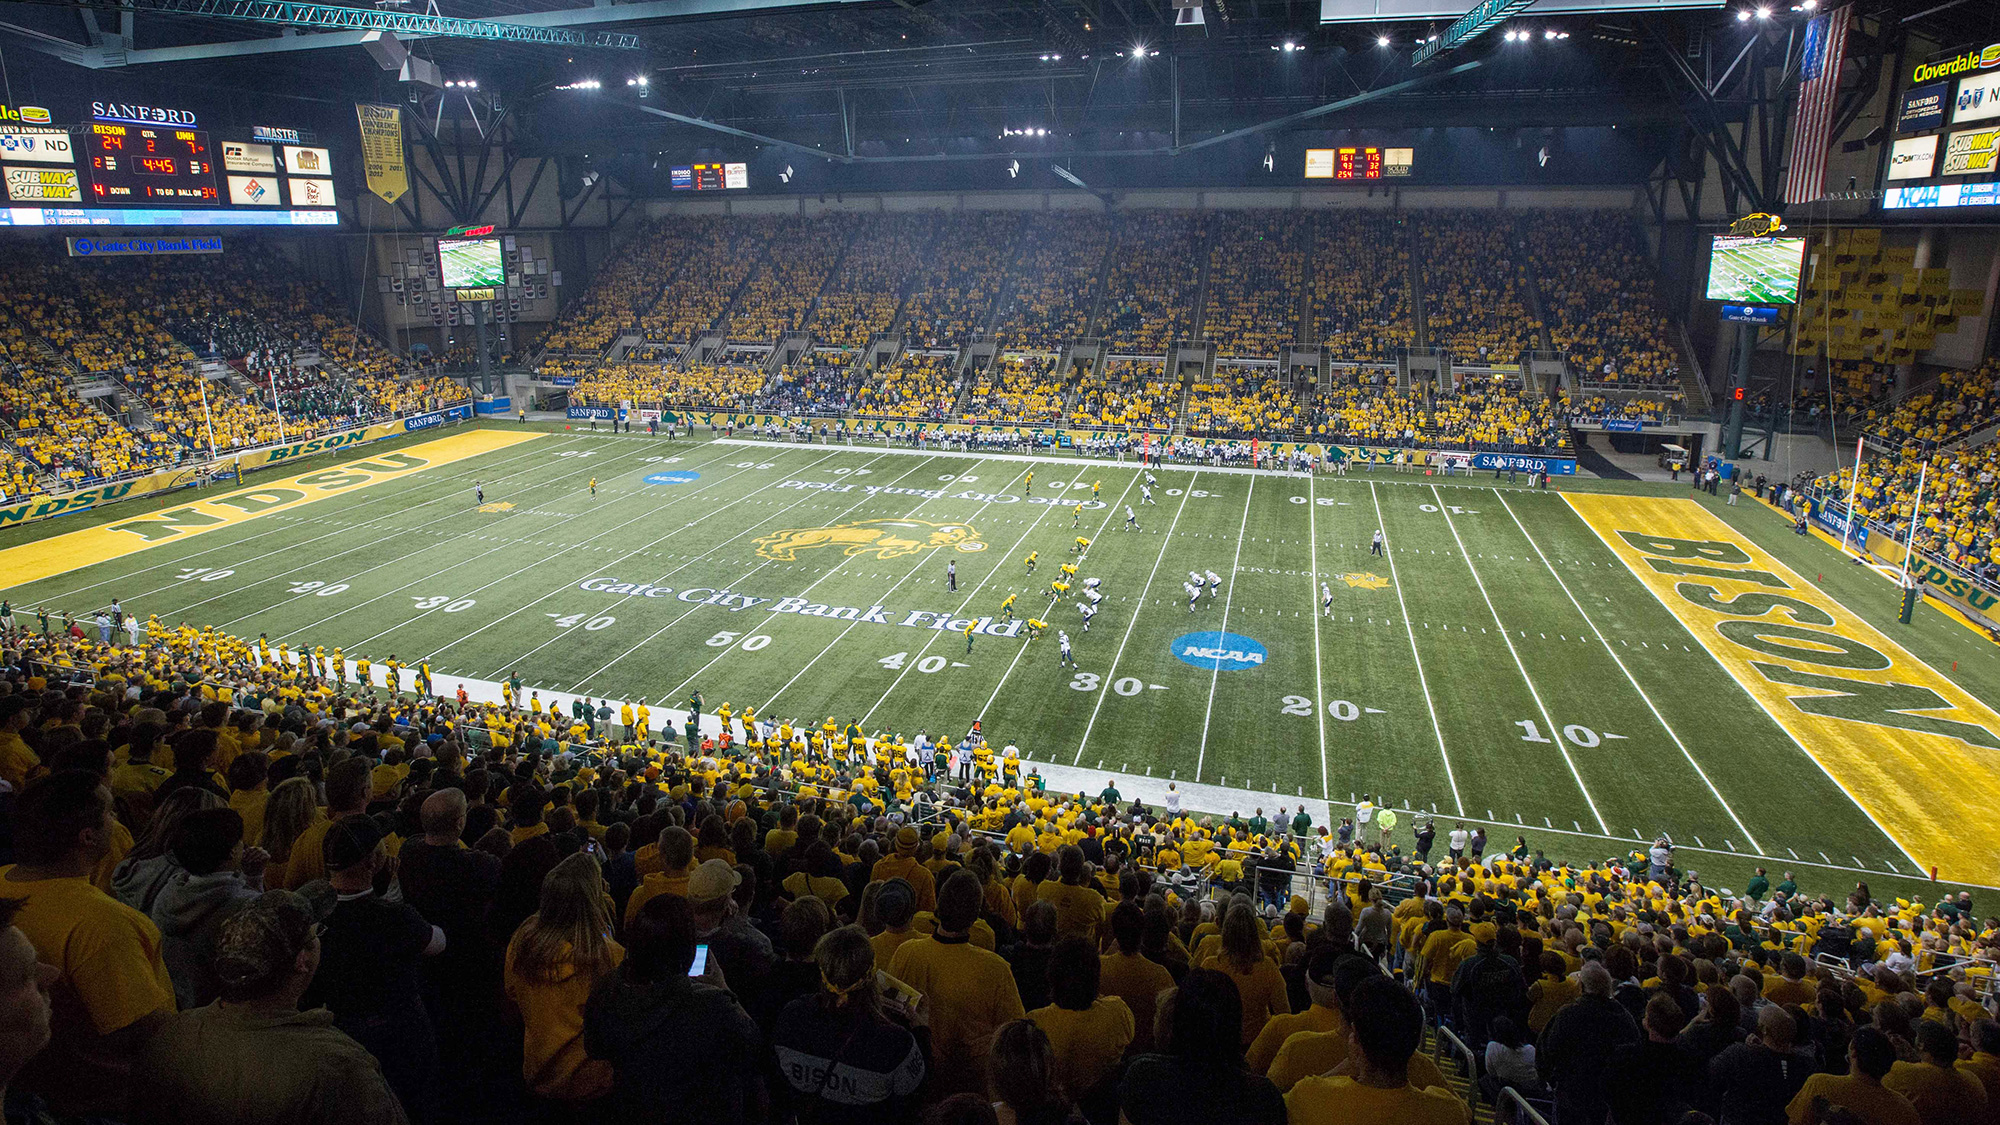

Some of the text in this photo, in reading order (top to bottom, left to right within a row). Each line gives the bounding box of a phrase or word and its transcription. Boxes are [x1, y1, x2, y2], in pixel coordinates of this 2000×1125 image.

[1913, 52, 1980, 82] Cloverdale
[1908, 95, 1940, 109] SANFORD
[92, 102, 196, 124] SANFORD
[93, 124, 126, 136] BISON
[176, 131, 196, 141] UNH
[264, 127, 298, 140] MASTER
[364, 128, 398, 138] CHAMPIONS
[1949, 130, 2000, 152] SUBWAY
[45, 140, 68, 152] ND
[102, 136, 196, 154] 24 2 7
[94, 157, 102, 168] 2
[144, 158, 174, 173] 4:45
[203, 163, 210, 173] 3
[1945, 150, 1998, 172] SUBWAY
[8, 170, 75, 184] SUBWAY
[11, 184, 78, 198] SUBWAY
[94, 184, 104, 196] 4
[110, 187, 130, 195] DOWN
[147, 186, 152, 196] 1
[202, 187, 216, 198] 34
[1898, 186, 1940, 208] NCAA
[1729, 218, 1770, 235] NDSU
[95, 238, 222, 254] Gate City Bank Field
[458, 288, 494, 300] NDSU
[1735, 388, 1743, 400] 6
[408, 414, 442, 428] SANFORD
[570, 408, 608, 418] SANFORD
[267, 429, 368, 463] BISON
[1482, 456, 1544, 470] SANFORD
[776, 480, 858, 492] Field
[860, 484, 948, 499] Bank
[0, 481, 136, 525] NDSU
[106, 452, 431, 543] NDSU
[950, 490, 1022, 504] City
[290, 581, 350, 597] 20
[1899, 554, 1998, 610] NDSU
[416, 596, 476, 612] 30
[580, 577, 1026, 638] Gate City Bank Field
[556, 612, 616, 632] 40
[706, 630, 772, 651] 50
[1614, 528, 2000, 750] BISON
[878, 652, 947, 674] 40
[1182, 646, 1263, 664] NCAA
[1070, 672, 1144, 697] 30
[1282, 695, 1360, 722] 20
[973, 722, 980, 731] 4
[1514, 720, 1600, 748] 10
[792, 1062, 857, 1093] BISON
